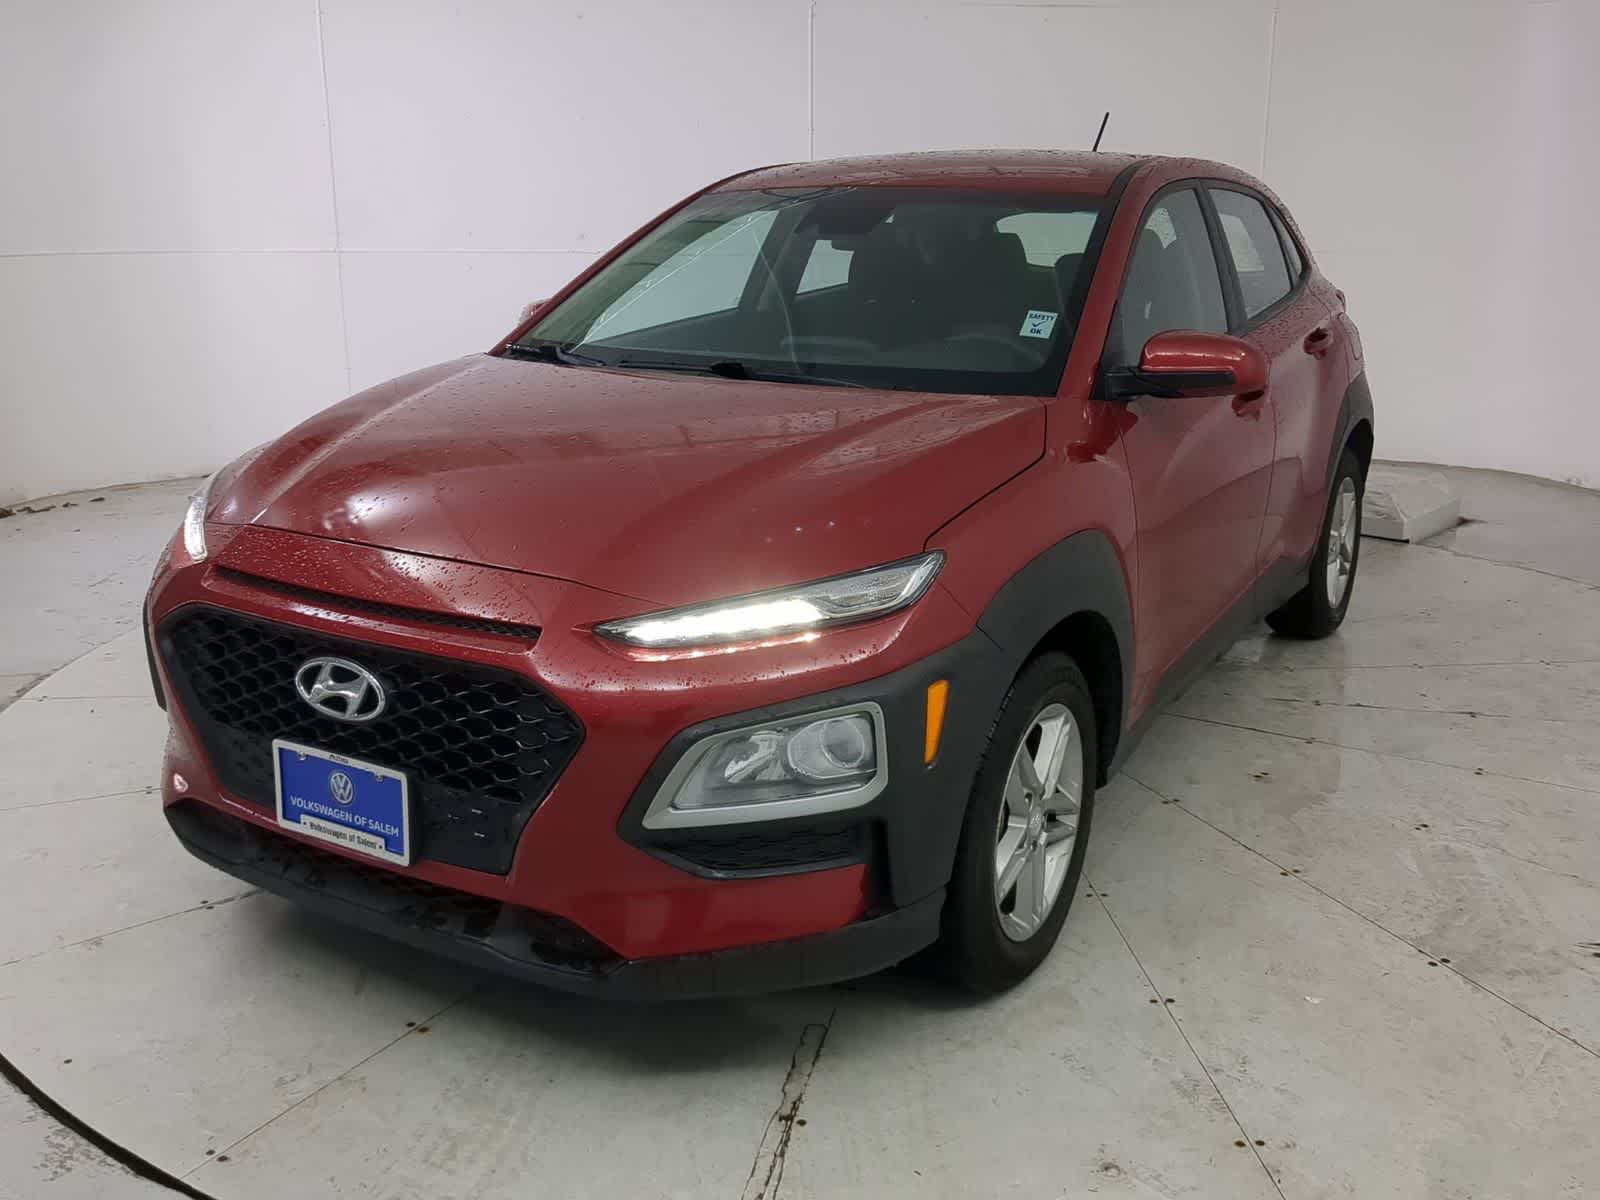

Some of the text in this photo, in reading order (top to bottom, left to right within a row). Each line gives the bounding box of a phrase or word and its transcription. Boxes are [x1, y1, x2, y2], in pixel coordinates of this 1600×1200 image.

[1029, 313, 1054, 321] SAFETY
[290, 795, 399, 837] VOLKSWAGEN OF SALEM
[309, 822, 348, 841] Volkswagen
[349, 832, 356, 842] of
